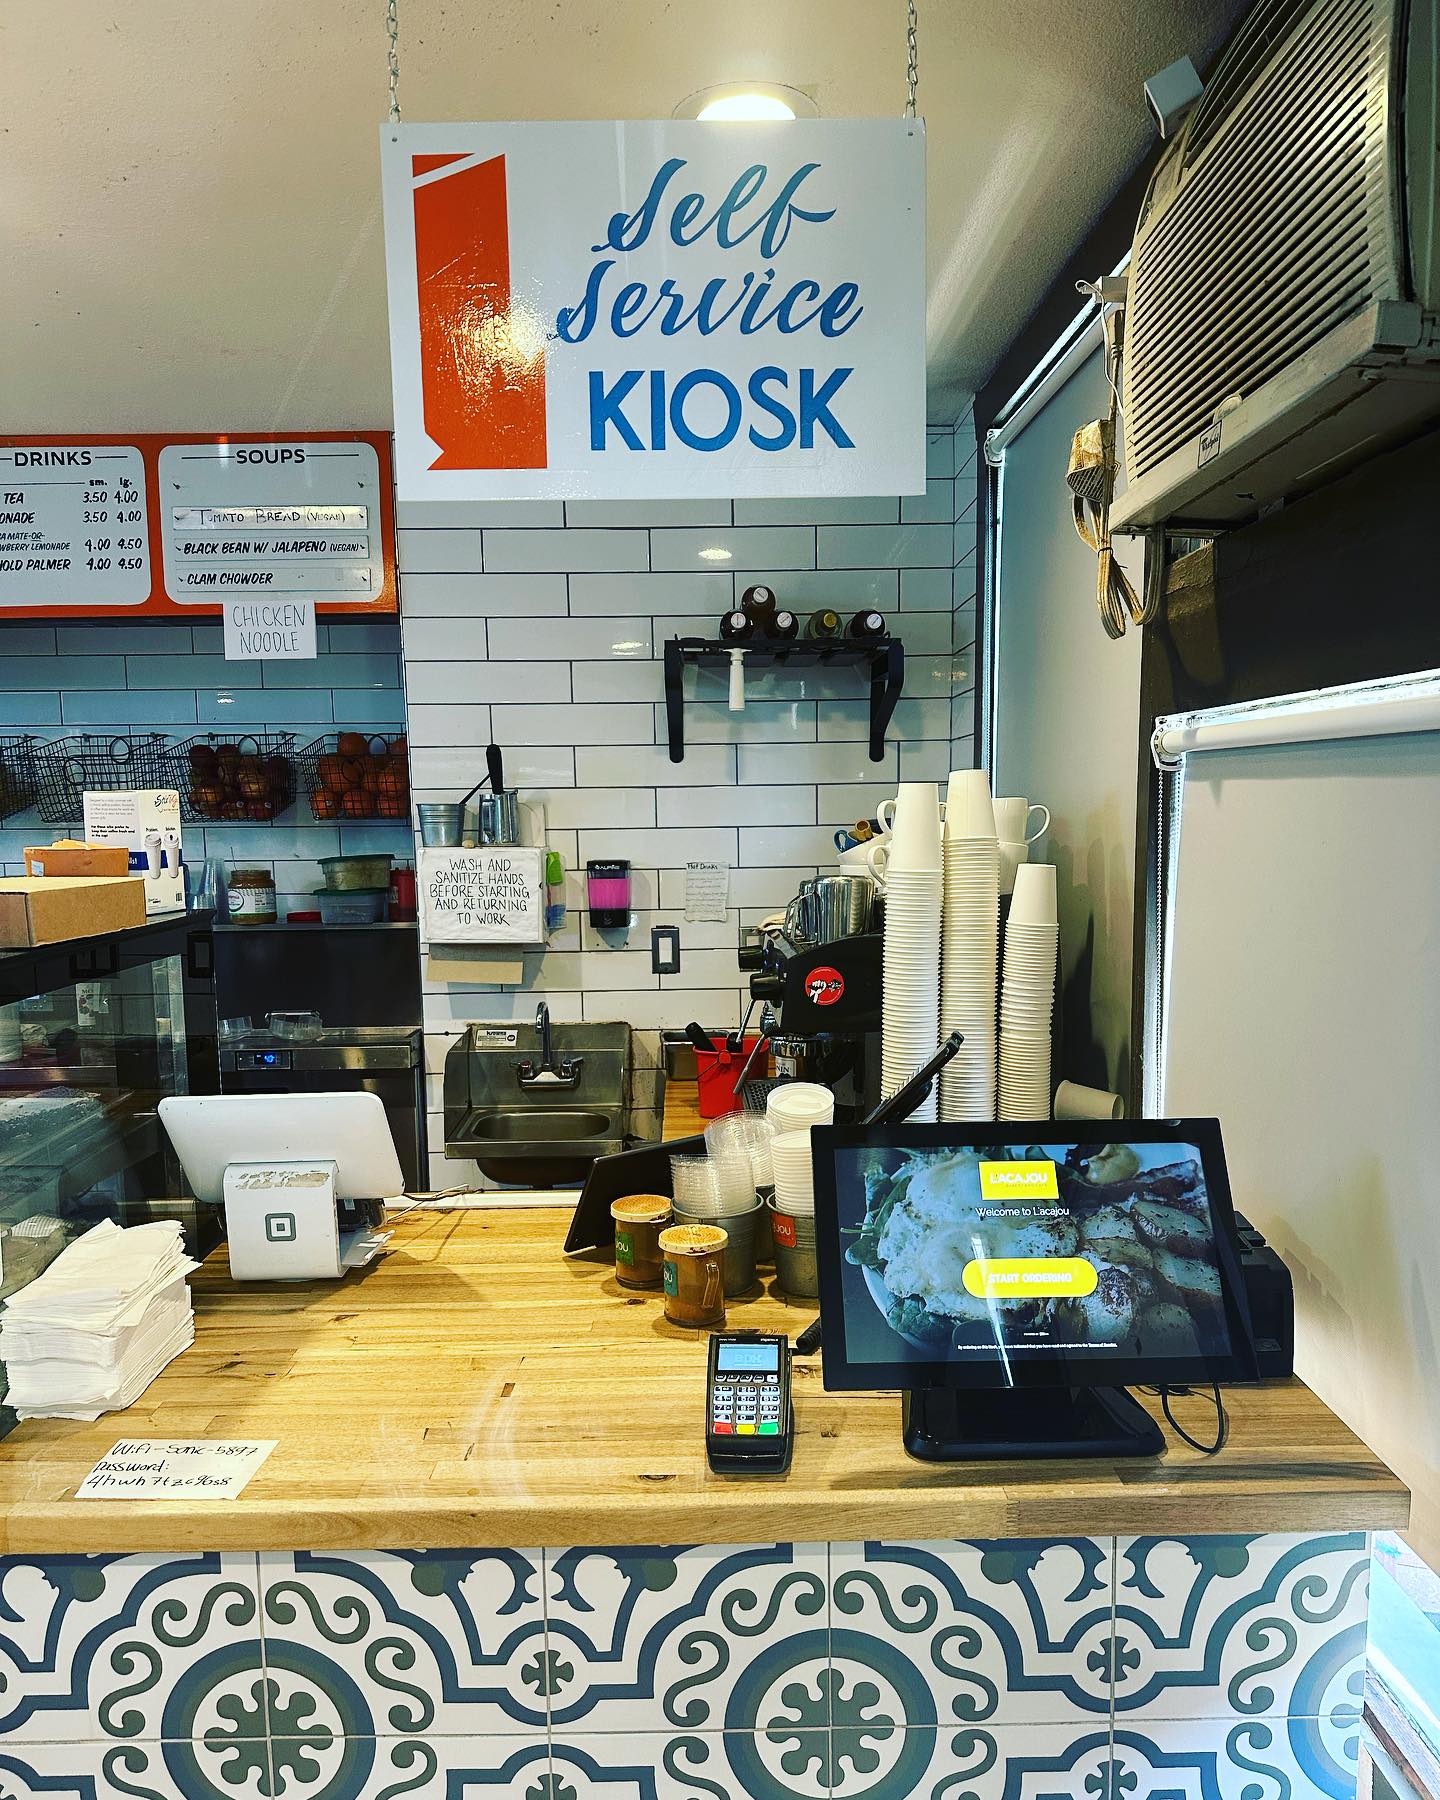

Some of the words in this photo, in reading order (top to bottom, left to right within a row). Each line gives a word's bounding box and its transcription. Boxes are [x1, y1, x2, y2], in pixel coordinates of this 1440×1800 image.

[591, 158, 837, 259] Self
[549, 260, 863, 343] Service
[589, 366, 856, 451] KIOSK
[14, 451, 92, 467] DRINKS
[236, 449, 307, 464] SOUPS
[119, 477, 133, 488] lg.
[3, 492, 24, 504] TEA
[83, 492, 108, 503] 3.50
[114, 490, 139, 504] 4.00
[83, 511, 108, 523] 3.50
[116, 511, 142, 524] 4.00
[256, 508, 300, 524] BREAD
[30, 541, 71, 552] LEMONADE
[85, 538, 111, 552] 4.00
[117, 538, 143, 550] 4.50
[184, 542, 218, 555] BLACK
[222, 542, 251, 554] BEAN
[253, 541, 269, 554] W/
[271, 541, 327, 553] JALAPENO
[330, 543, 359, 553] (VEGAN)
[26, 558, 72, 571] PALMER
[86, 558, 111, 571] 4.00
[117, 558, 143, 570] 4.50
[187, 573, 217, 585] CLAM
[219, 573, 274, 584] CHOWDER
[233, 604, 306, 627] CHICKEN
[240, 631, 299, 653] NOODLE
[449, 858, 482, 871] WASH
[488, 858, 512, 872] AND
[435, 871, 484, 884] SANITIZE
[489, 873, 524, 886] HANDS
[430, 884, 473, 897] BEFORE
[478, 885, 530, 899] STARTING
[435, 898, 458, 910] AND
[463, 898, 528, 912] RETURNING
[457, 912, 471, 924] TO
[477, 912, 510, 926] WORK
[975, 1207, 1020, 1217] Welcome
[1022, 1207, 1032, 1216] to
[989, 1273, 1019, 1284] START
[1022, 1273, 1072, 1283] ORDERING
